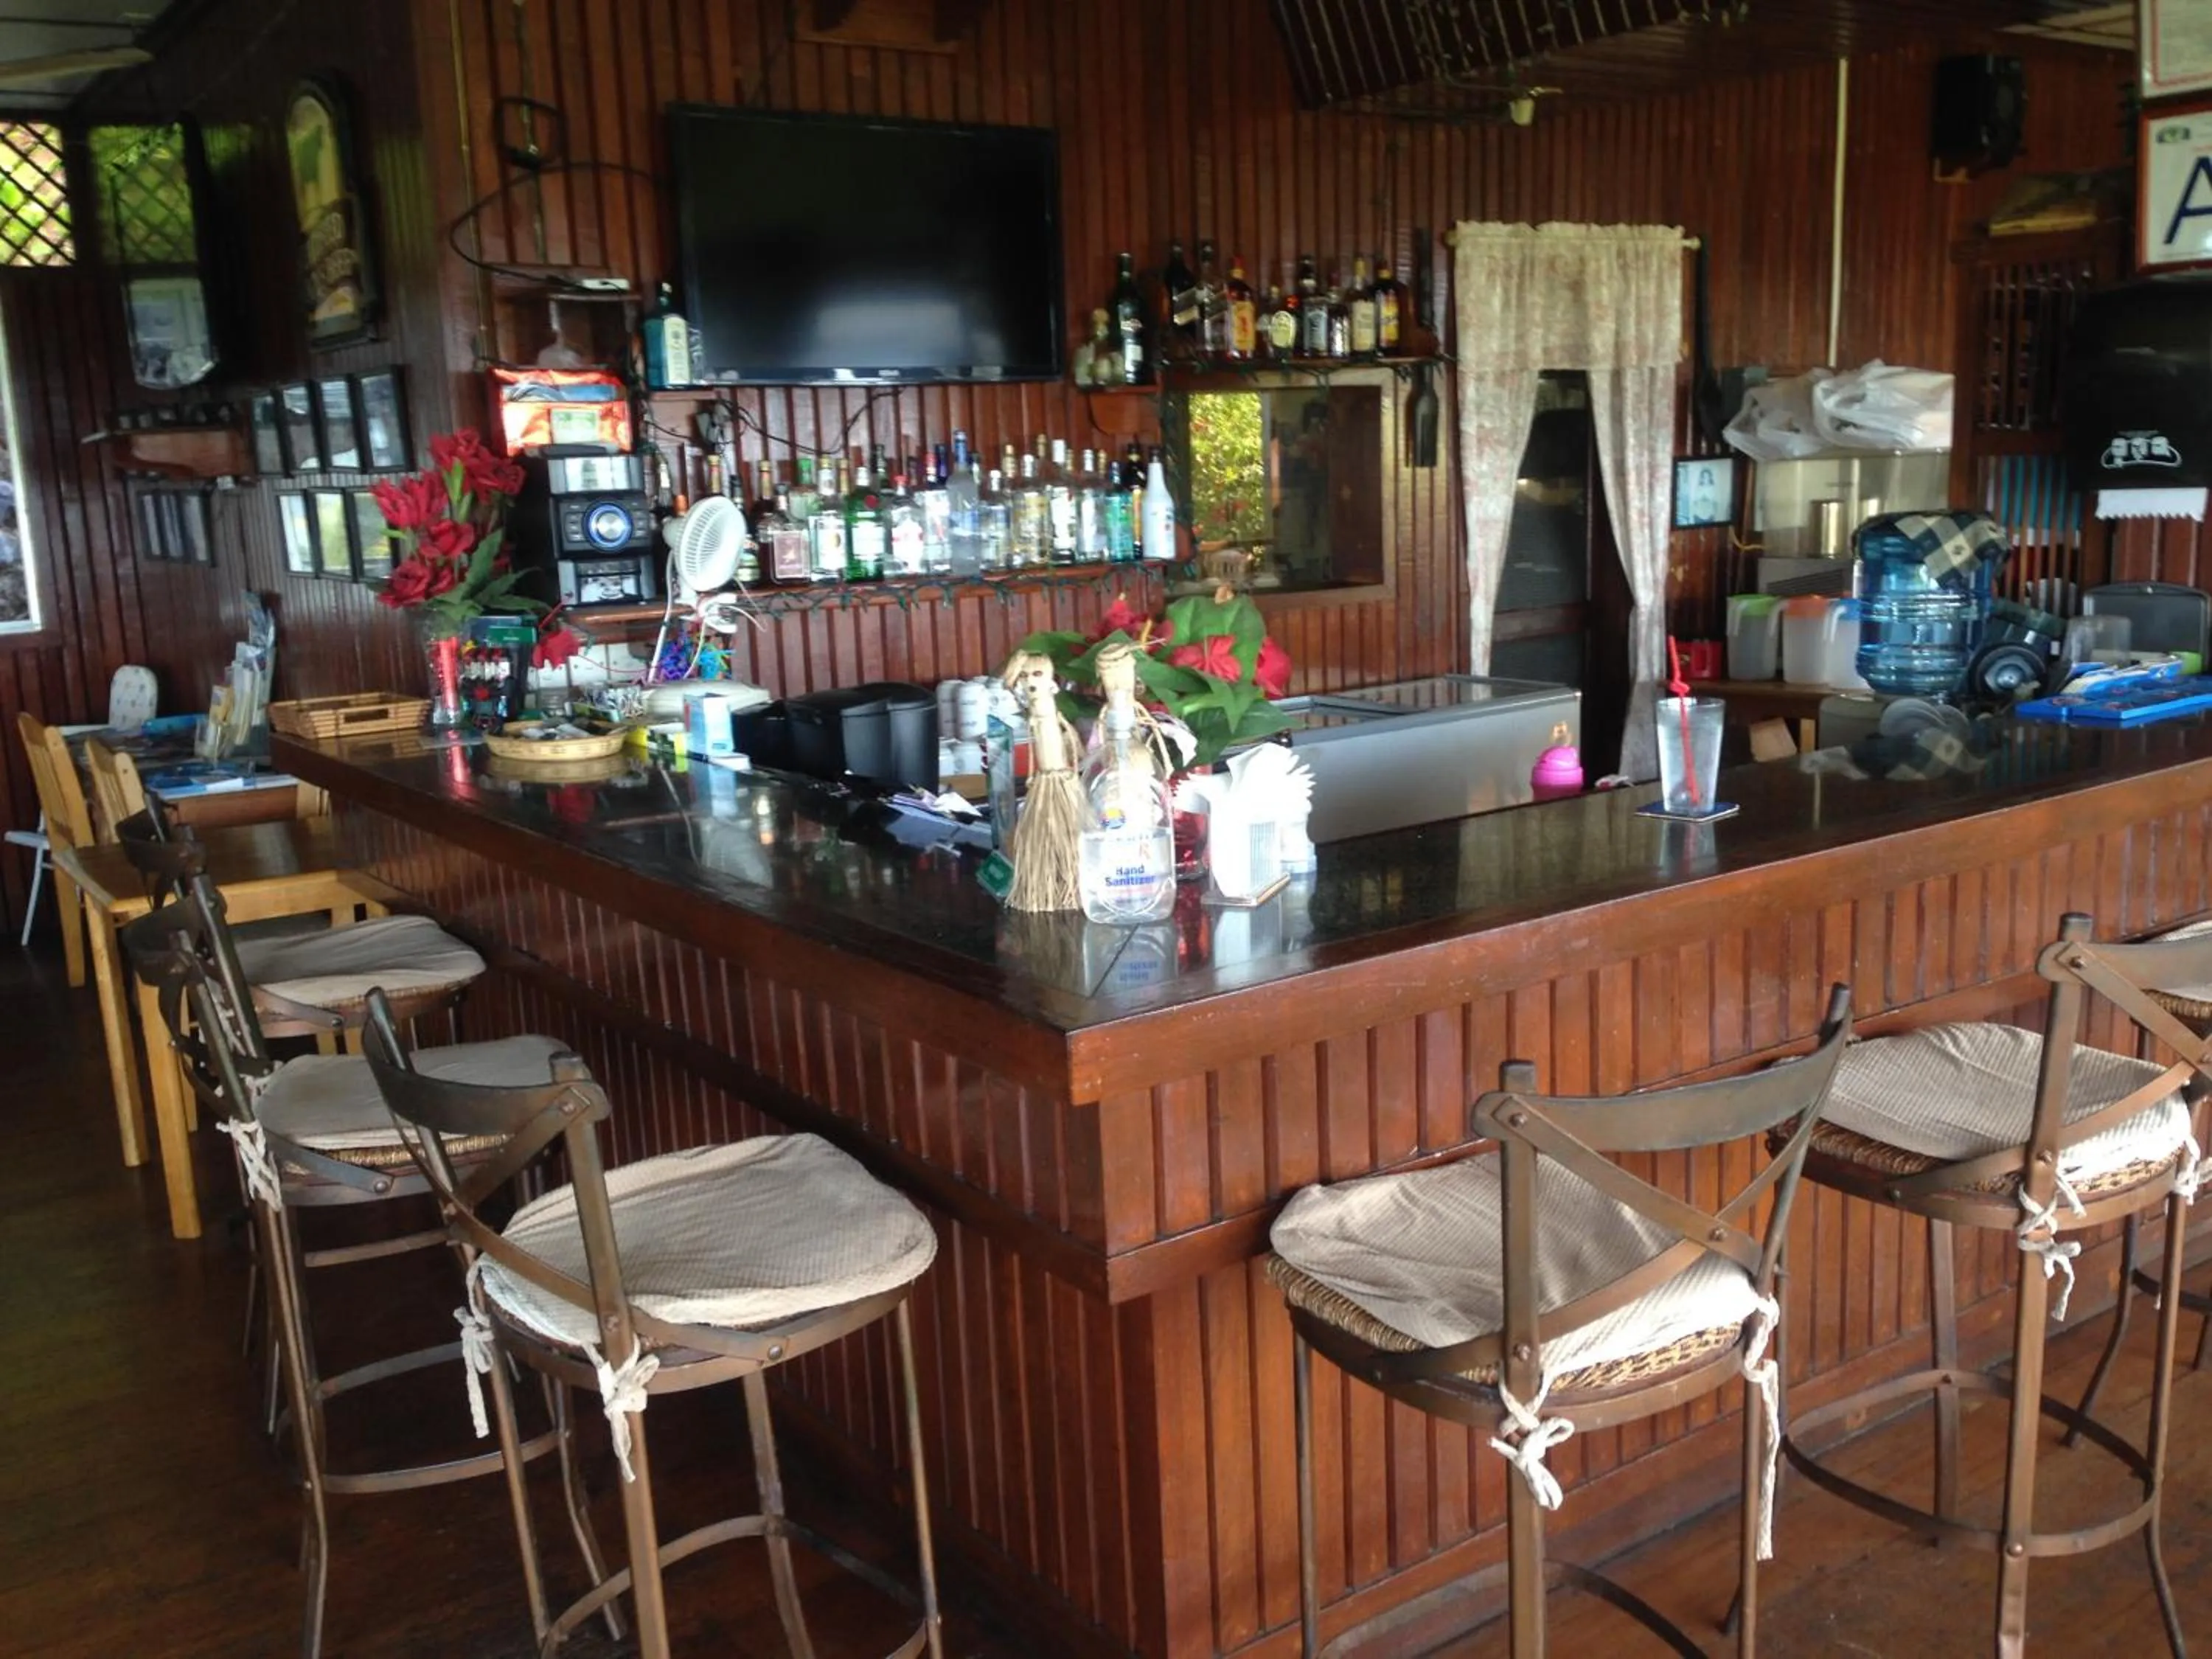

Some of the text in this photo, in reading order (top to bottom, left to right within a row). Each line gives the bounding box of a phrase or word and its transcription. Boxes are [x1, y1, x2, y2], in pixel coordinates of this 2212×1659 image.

[2164, 156, 2212, 244] A
[1116, 865, 1144, 875] Hand
[1105, 875, 1155, 886] Sanitizer
